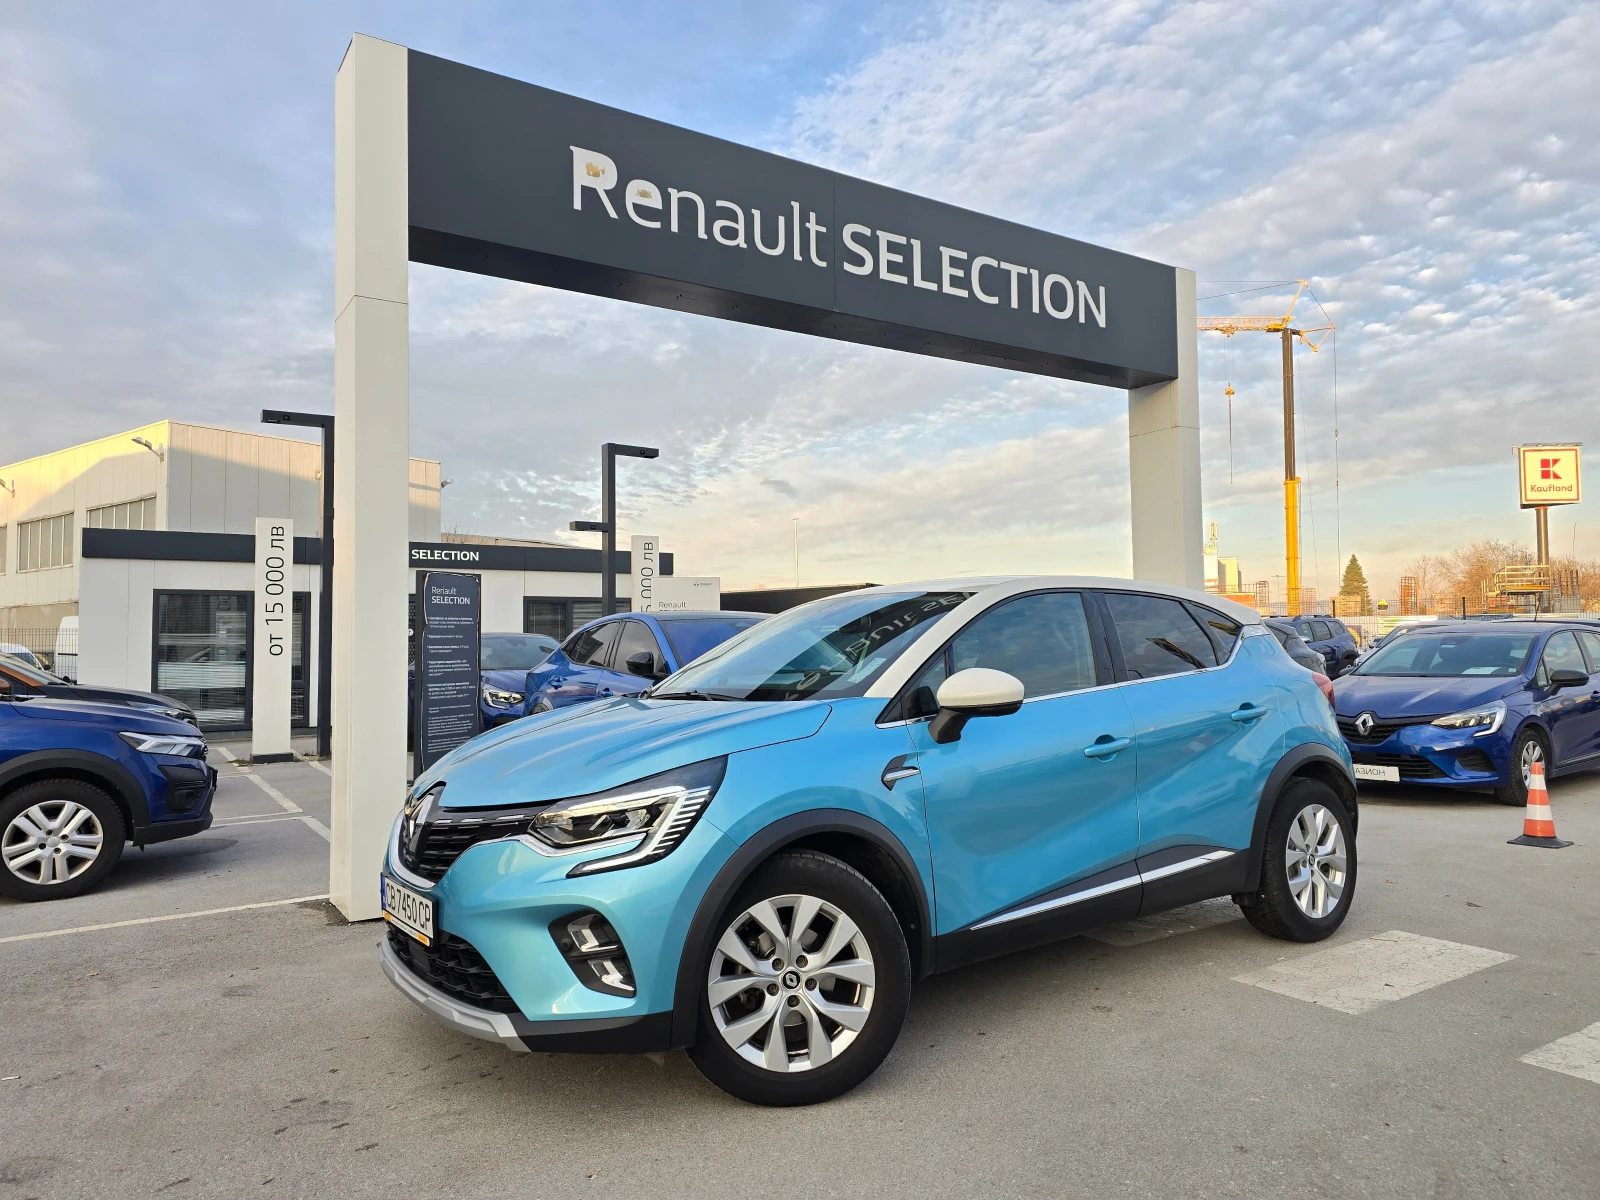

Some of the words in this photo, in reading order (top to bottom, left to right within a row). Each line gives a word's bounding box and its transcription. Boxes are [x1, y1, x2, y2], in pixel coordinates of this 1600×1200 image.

[569, 145, 827, 268] Renault
[843, 223, 1107, 328] SELECTION
[1530, 484, 1573, 492] Kaufland
[411, 549, 479, 561] SELECTION
[265, 556, 284, 596] 000
[431, 586, 457, 595] Renault
[431, 595, 471, 605] SELECTION
[658, 601, 687, 609] Renault
[265, 602, 283, 626] 15
[397, 889, 417, 924] 7450
